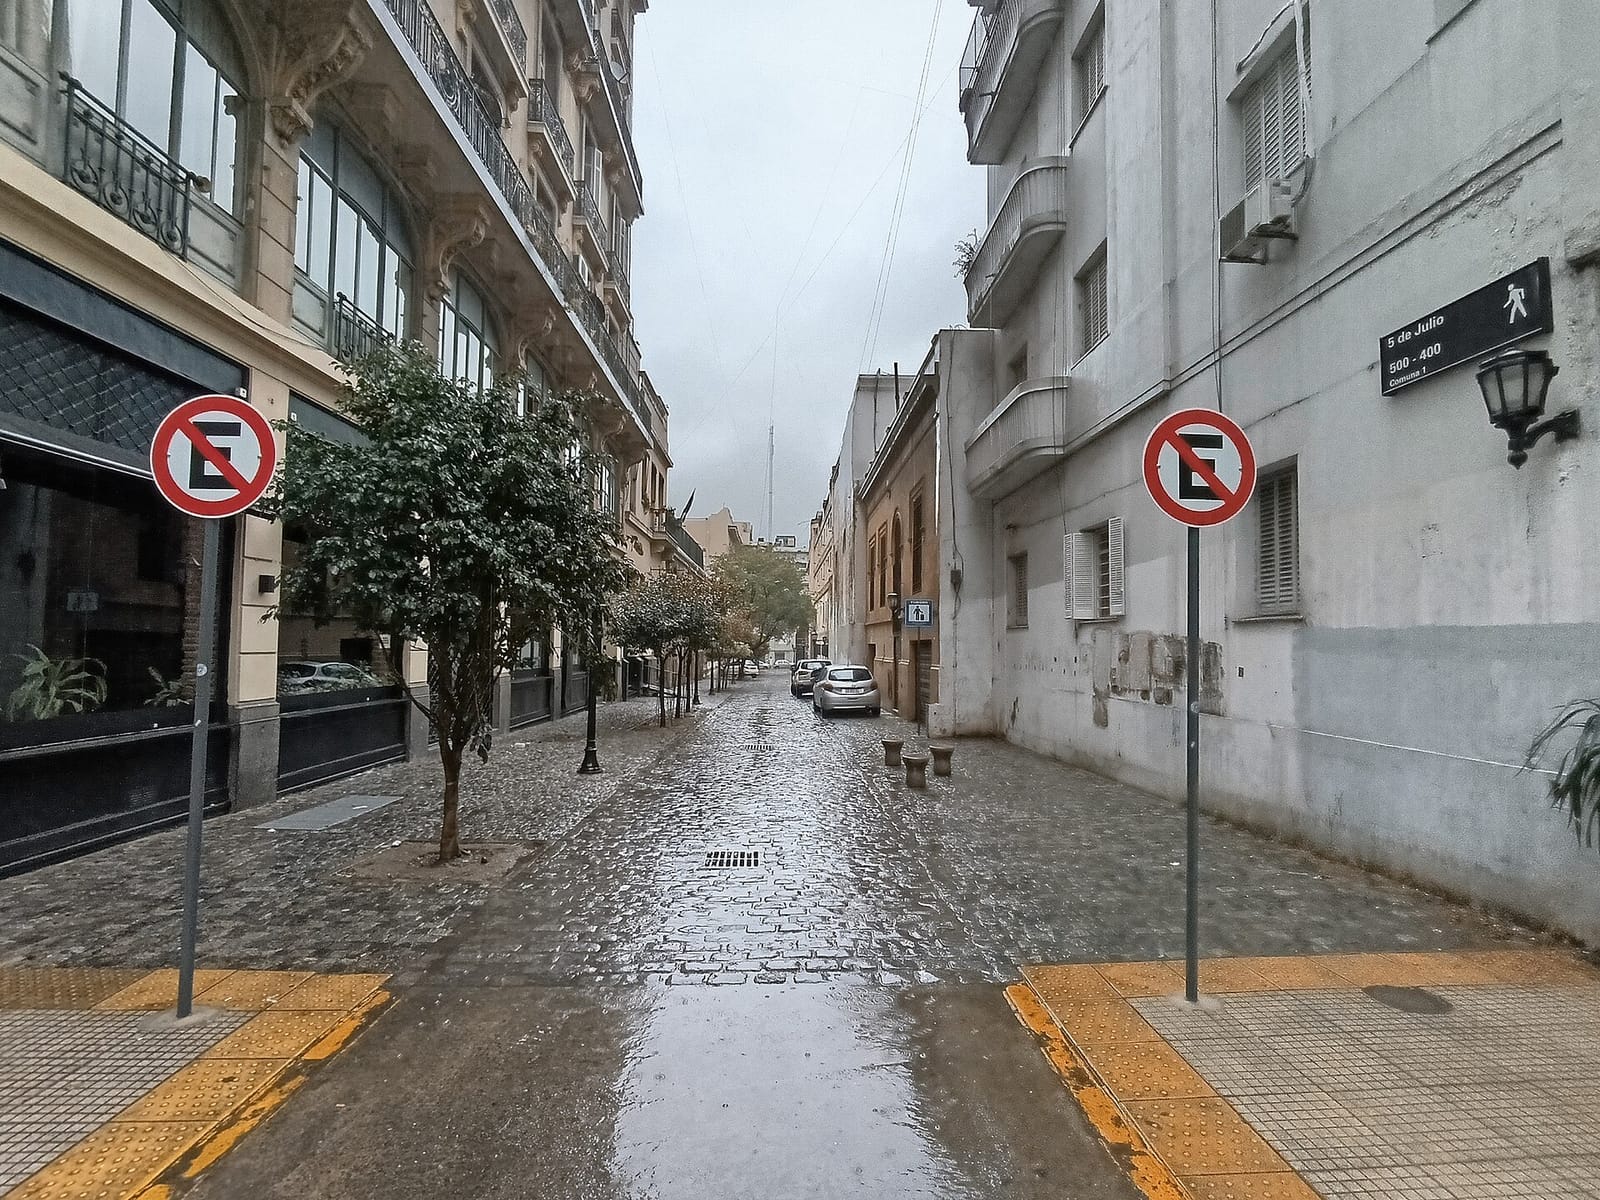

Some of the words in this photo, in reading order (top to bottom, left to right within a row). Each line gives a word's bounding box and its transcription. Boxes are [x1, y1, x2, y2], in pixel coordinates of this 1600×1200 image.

[1387, 336, 1395, 348] 5
[1397, 331, 1412, 343] de
[1414, 316, 1444, 336] Julio
[1389, 356, 1410, 374] 500
[1419, 342, 1441, 360] 400
[1389, 370, 1420, 387] Comuna
[1421, 366, 1426, 374] 1
[189, 422, 241, 489] E
[1179, 433, 1224, 500] E
